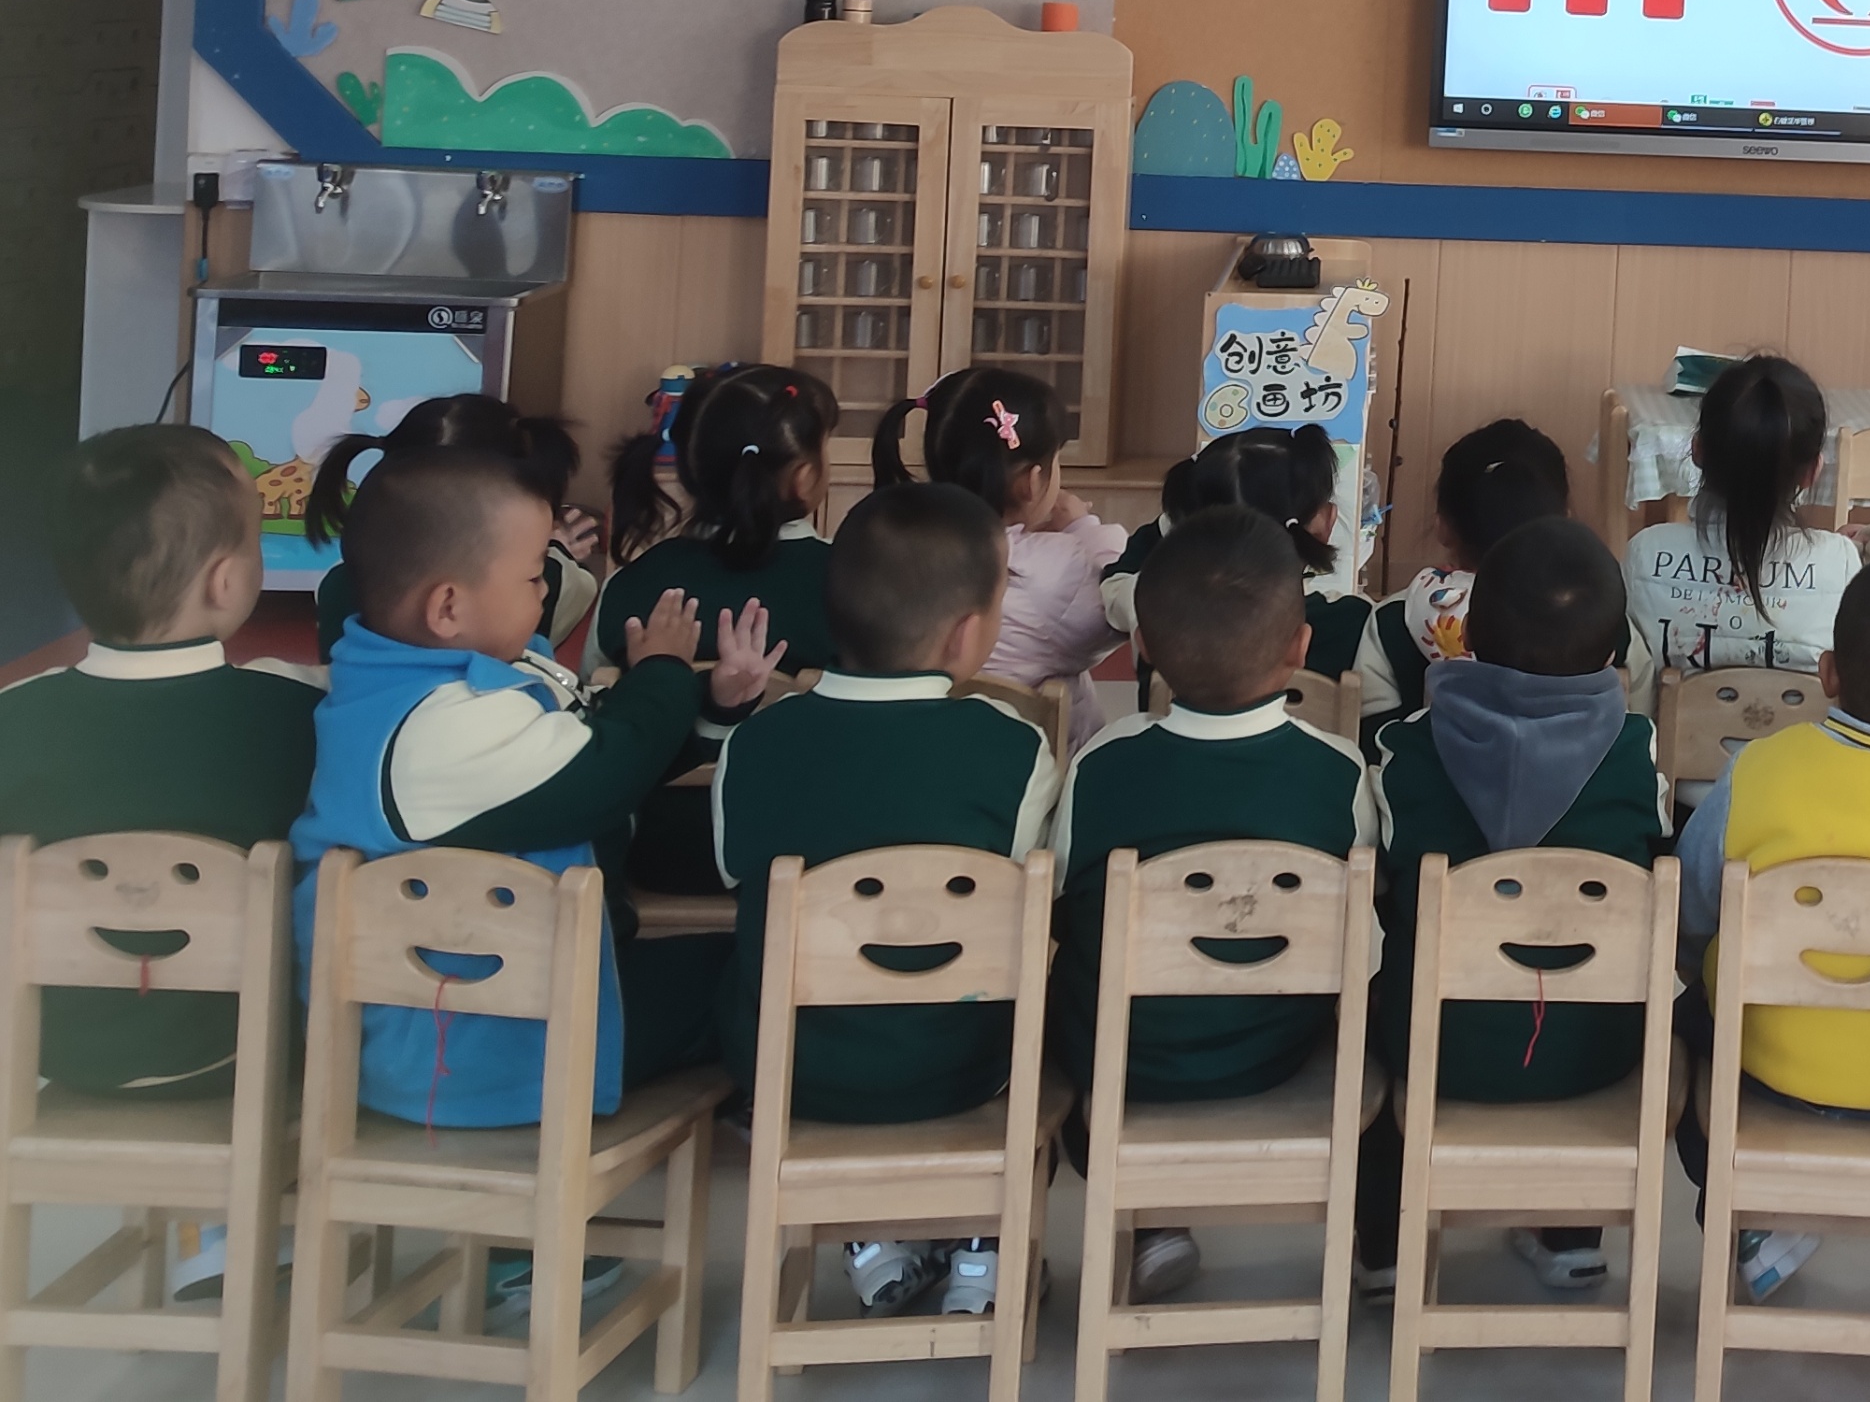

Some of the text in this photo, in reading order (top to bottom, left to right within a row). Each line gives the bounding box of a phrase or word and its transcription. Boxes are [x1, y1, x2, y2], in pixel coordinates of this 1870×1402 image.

[1742, 145, 1779, 156] seewo
[1219, 330, 1301, 376] 创意
[1256, 375, 1343, 417] 画坊
[1670, 586, 1693, 601] DE
